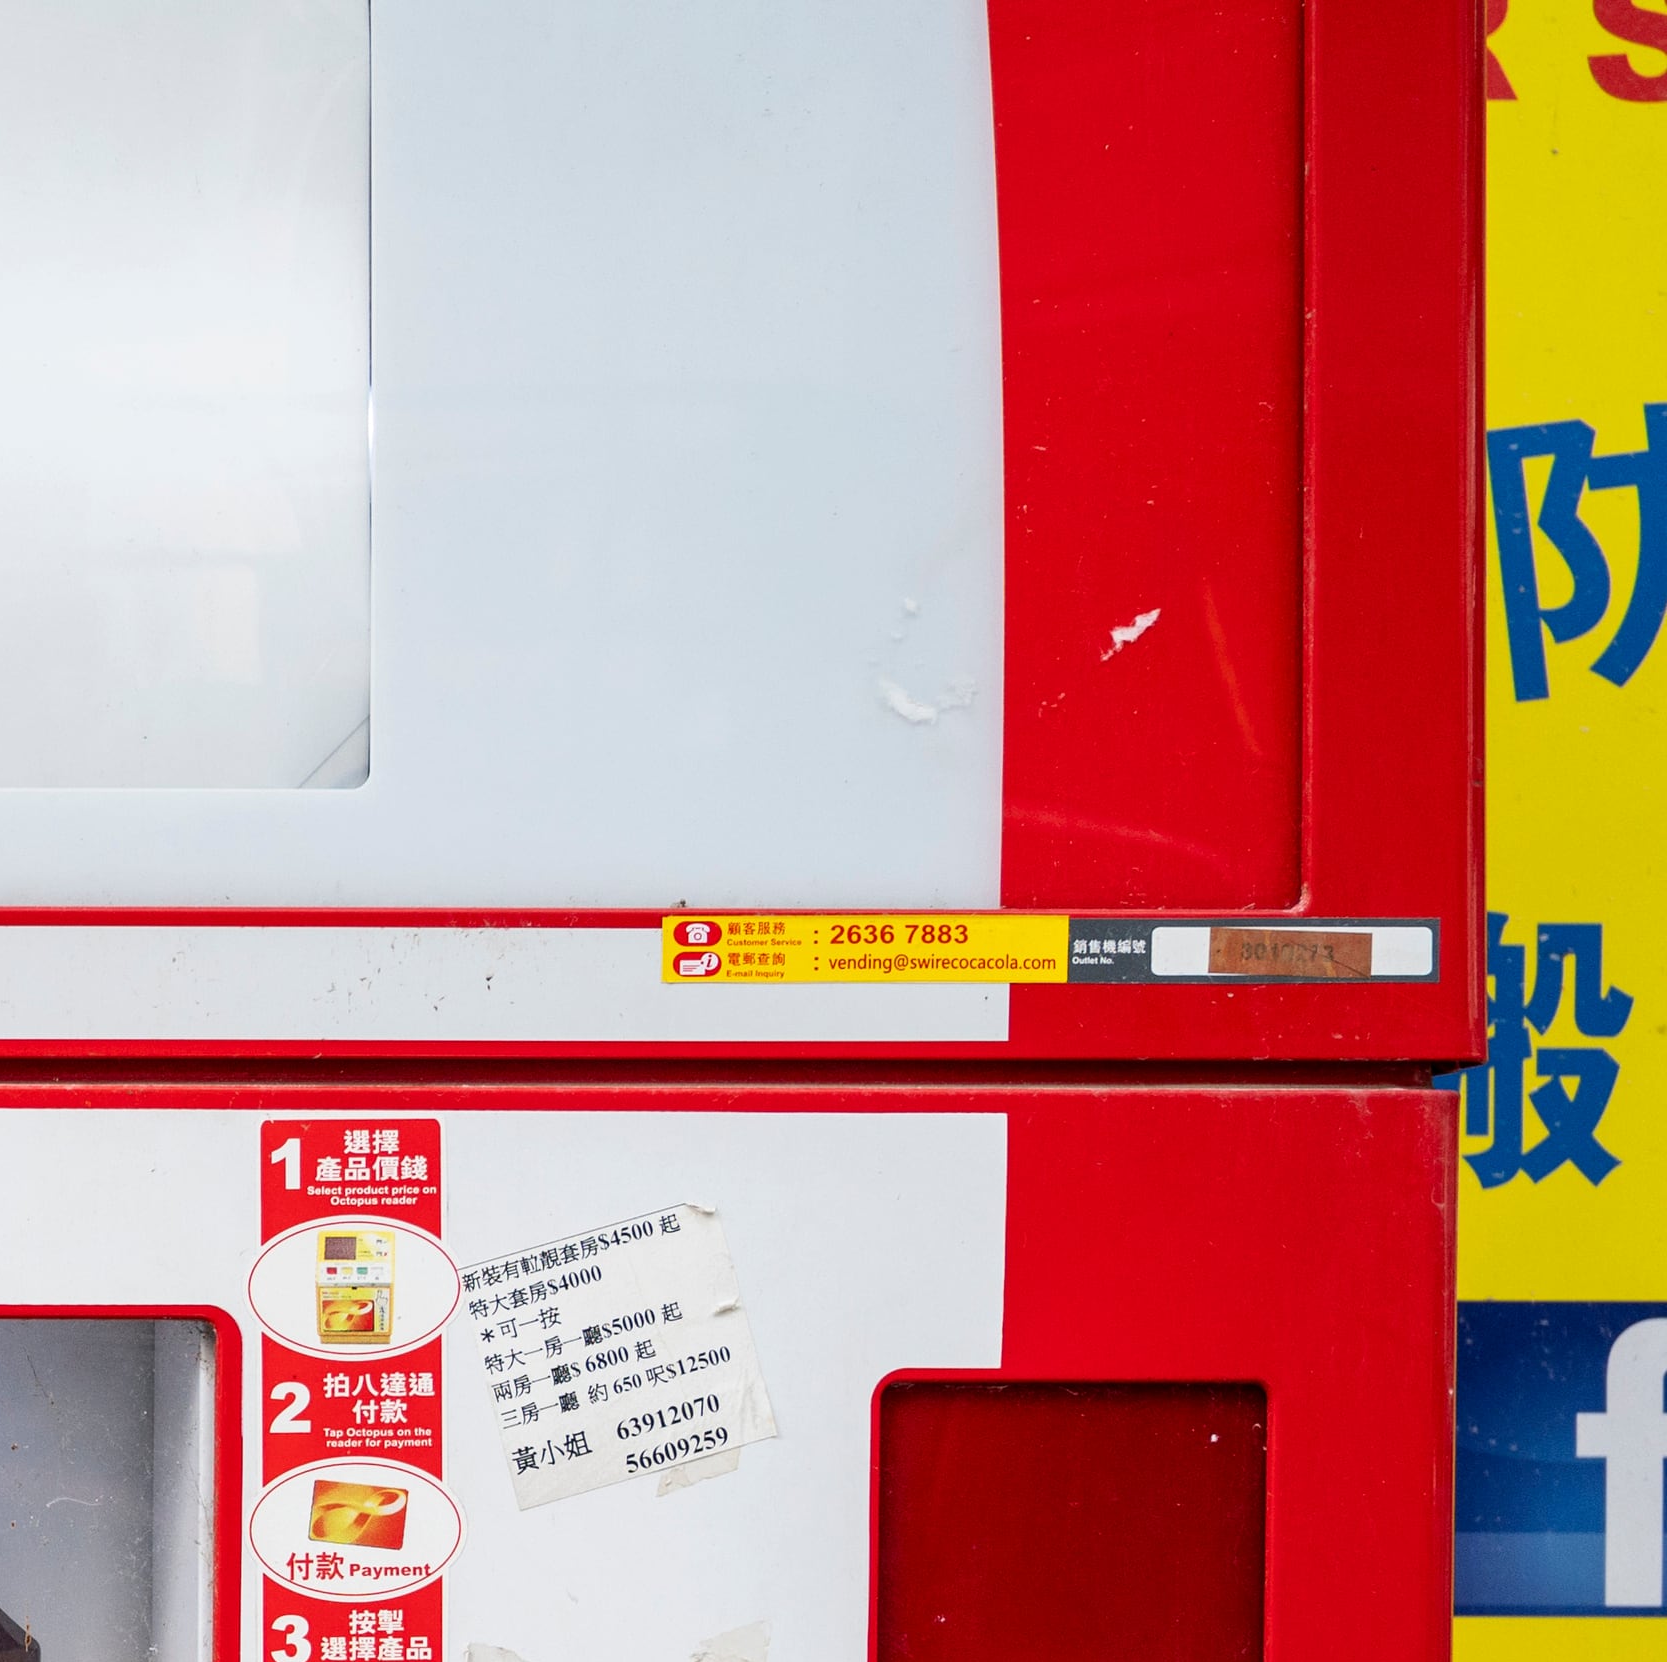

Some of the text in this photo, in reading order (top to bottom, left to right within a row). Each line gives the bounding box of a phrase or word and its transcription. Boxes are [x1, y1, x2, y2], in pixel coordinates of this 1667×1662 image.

[727, 922, 786, 935] 顧客服務
[830, 924, 968, 945] 2636 7883
[1073, 939, 1146, 954] 銷售機編號
[727, 953, 785, 966] 電郵查詢
[829, 954, 1056, 974] vending@swirecocacola.com
[1072, 956, 1114, 964] Outlet No.
[727, 970, 784, 979] E-mail Inquiry
[344, 1129, 399, 1154] 選擇
[271, 1138, 300, 1190] 1
[315, 1155, 428, 1181] 產品價錢
[307, 1186, 341, 1195] Select
[345, 1186, 388, 1198] product
[392, 1186, 419, 1197] price
[330, 1196, 417, 1207] Octopus reader
[659, 1213, 681, 1235] 起
[469, 1265, 602, 1320] 特大套房$4000
[661, 1302, 683, 1323] 起
[585, 1346, 629, 1373] 6800
[635, 1340, 656, 1361] 起
[323, 1373, 435, 1398] 拍八達通
[269, 1382, 311, 1433] 2
[352, 1399, 407, 1424] 付款
[500, 1391, 579, 1430] 三房一廳
[588, 1383, 608, 1404] 約
[613, 1373, 642, 1395] 650
[323, 1428, 343, 1438] Tap
[346, 1428, 393, 1438] Octopus
[414, 1428, 432, 1436] the
[326, 1438, 432, 1449] reader for payment
[512, 1393, 720, 1476] 黃小姐 63912070
[626, 1426, 729, 1473] 56609259
[286, 1552, 430, 1580] 付款 Payment
[349, 1609, 404, 1635] 按掣
[321, 1636, 432, 1661] 選擇產品
